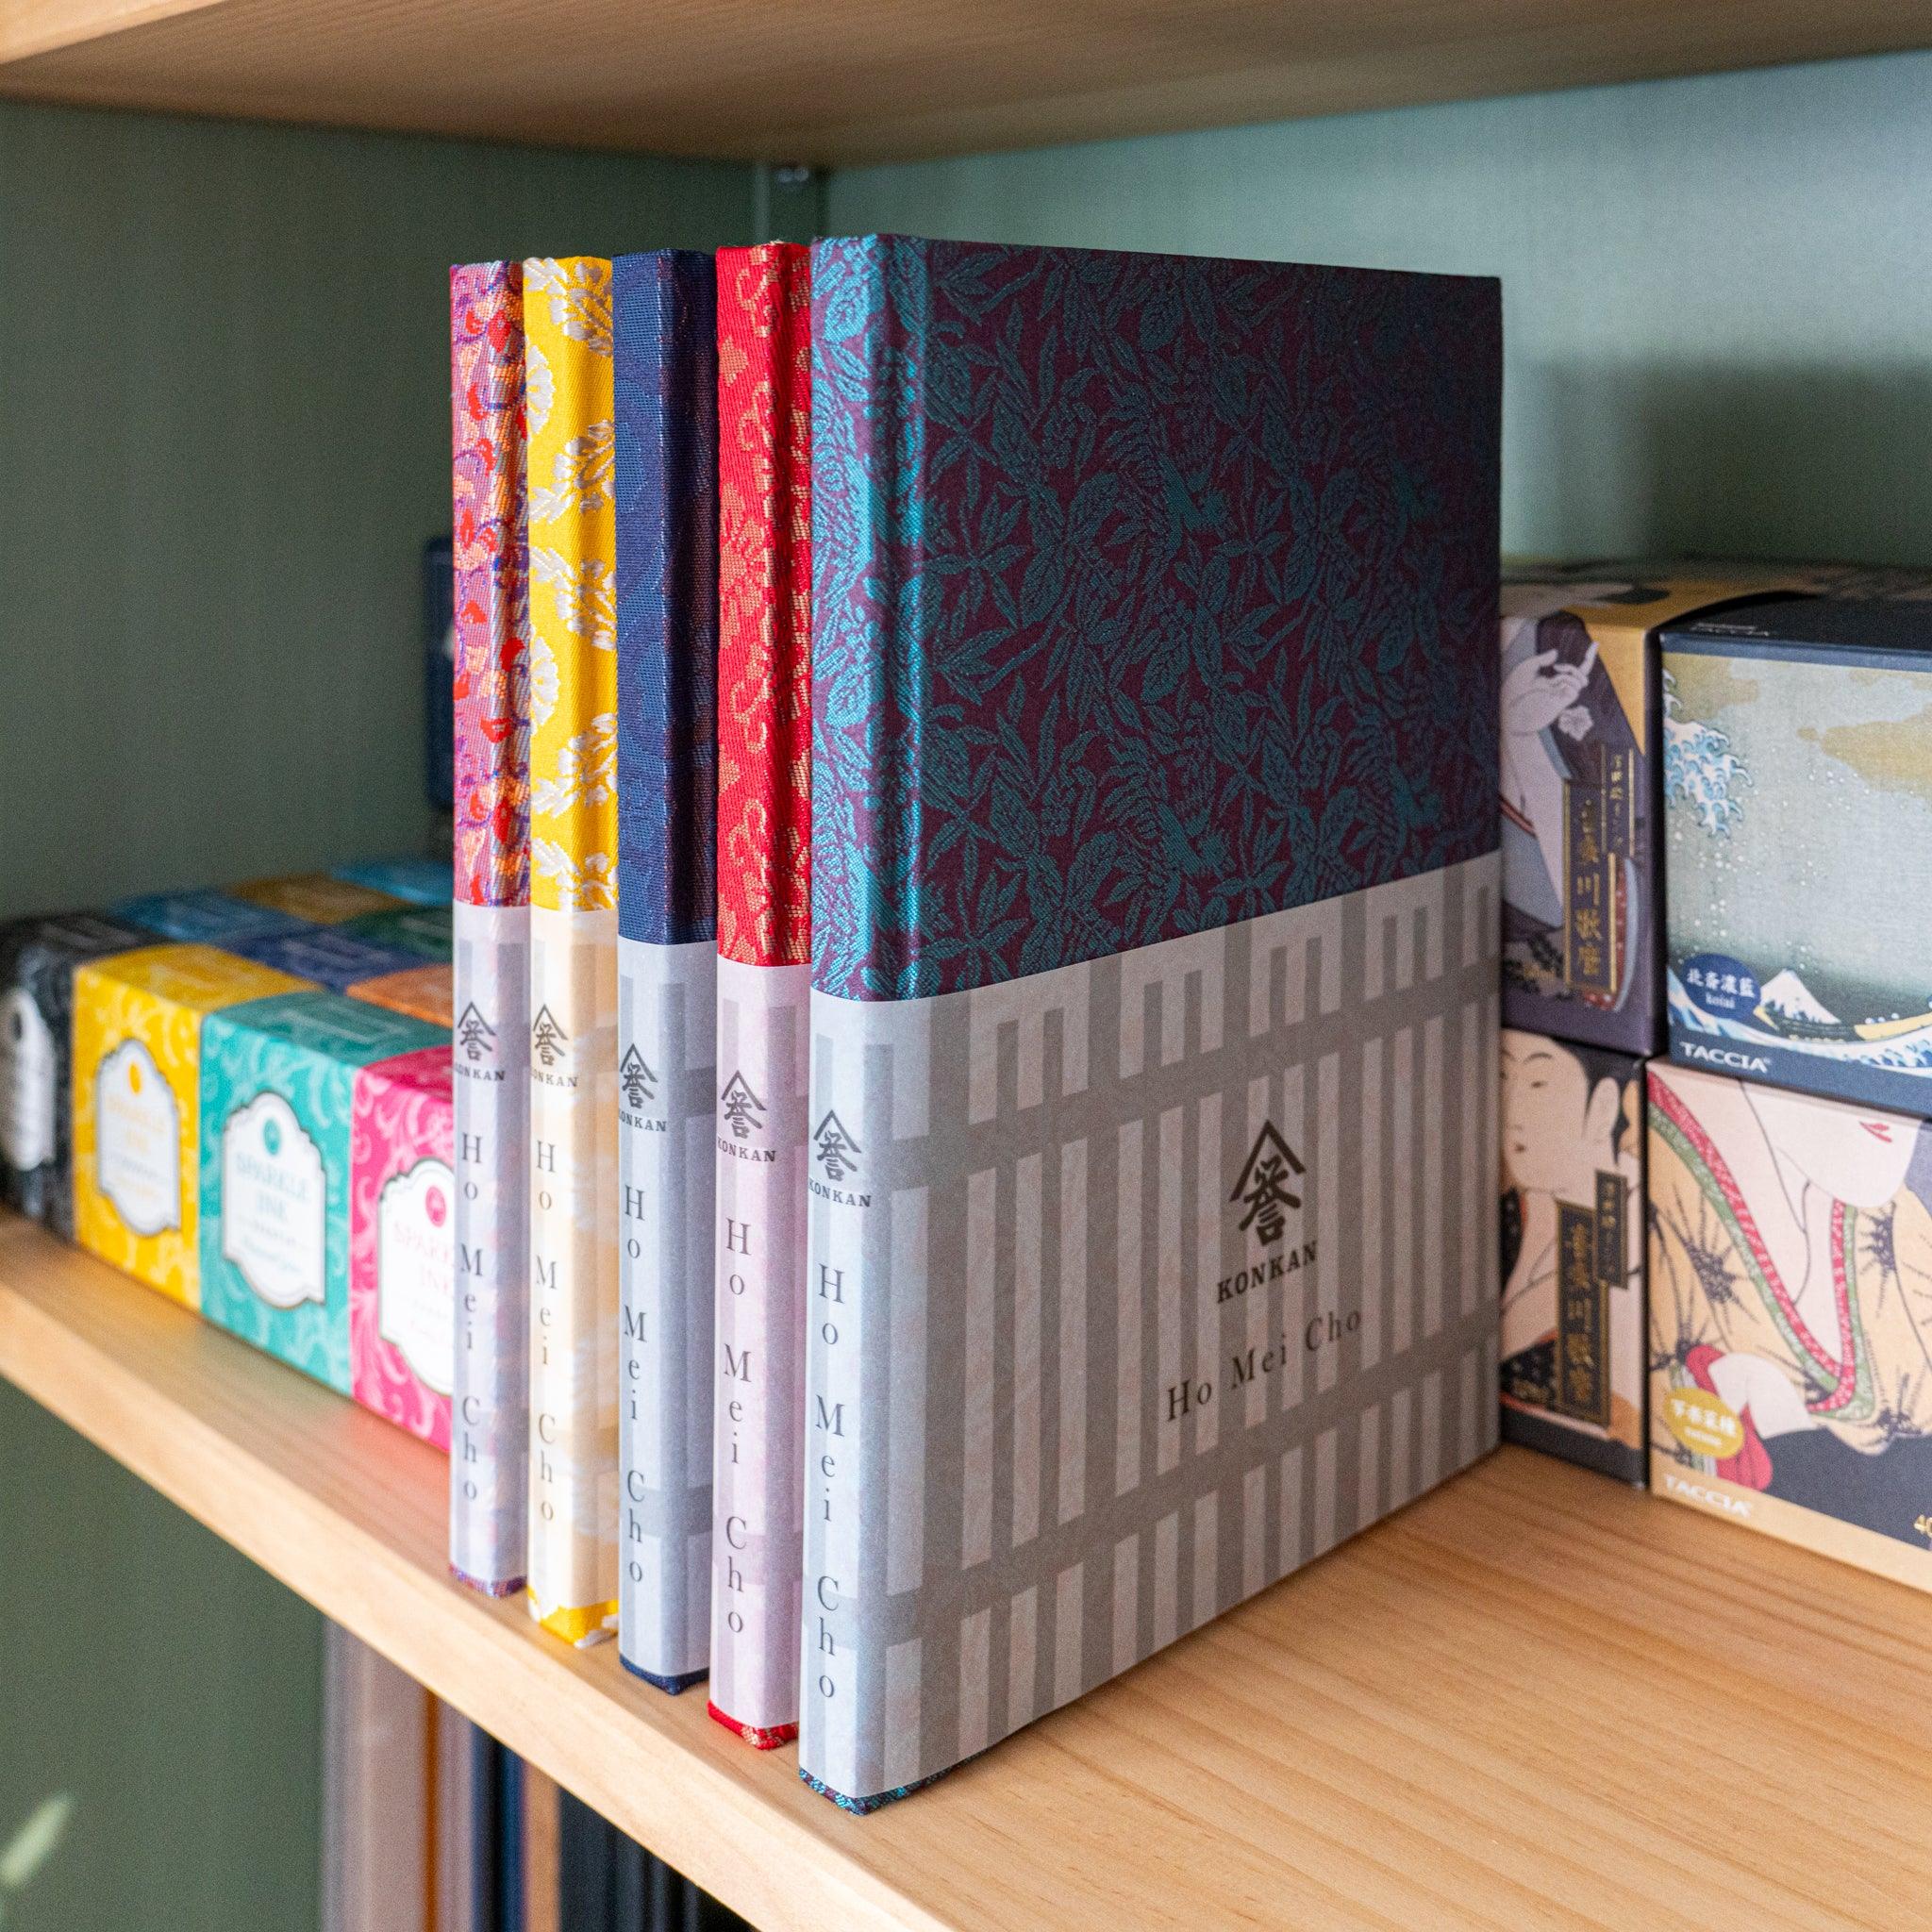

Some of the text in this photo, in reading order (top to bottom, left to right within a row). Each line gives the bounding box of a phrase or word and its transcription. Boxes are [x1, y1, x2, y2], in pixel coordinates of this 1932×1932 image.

[531, 1067, 579, 1088] ONKAN
[1678, 1041, 1770, 1074] TACCIA
[459, 1132, 484, 1501] Ho Mei Cho
[535, 1139, 558, 1522] Ho Mei Cho
[623, 1183, 648, 1584] Ho Mei Cho
[723, 1217, 753, 1634] Ho Mei Cho
[1167, 1310, 1362, 1422] Ho Mei Cho
[1216, 1240, 1318, 1305] KONKAN
[815, 1262, 846, 1699] Ho Mei Cho
